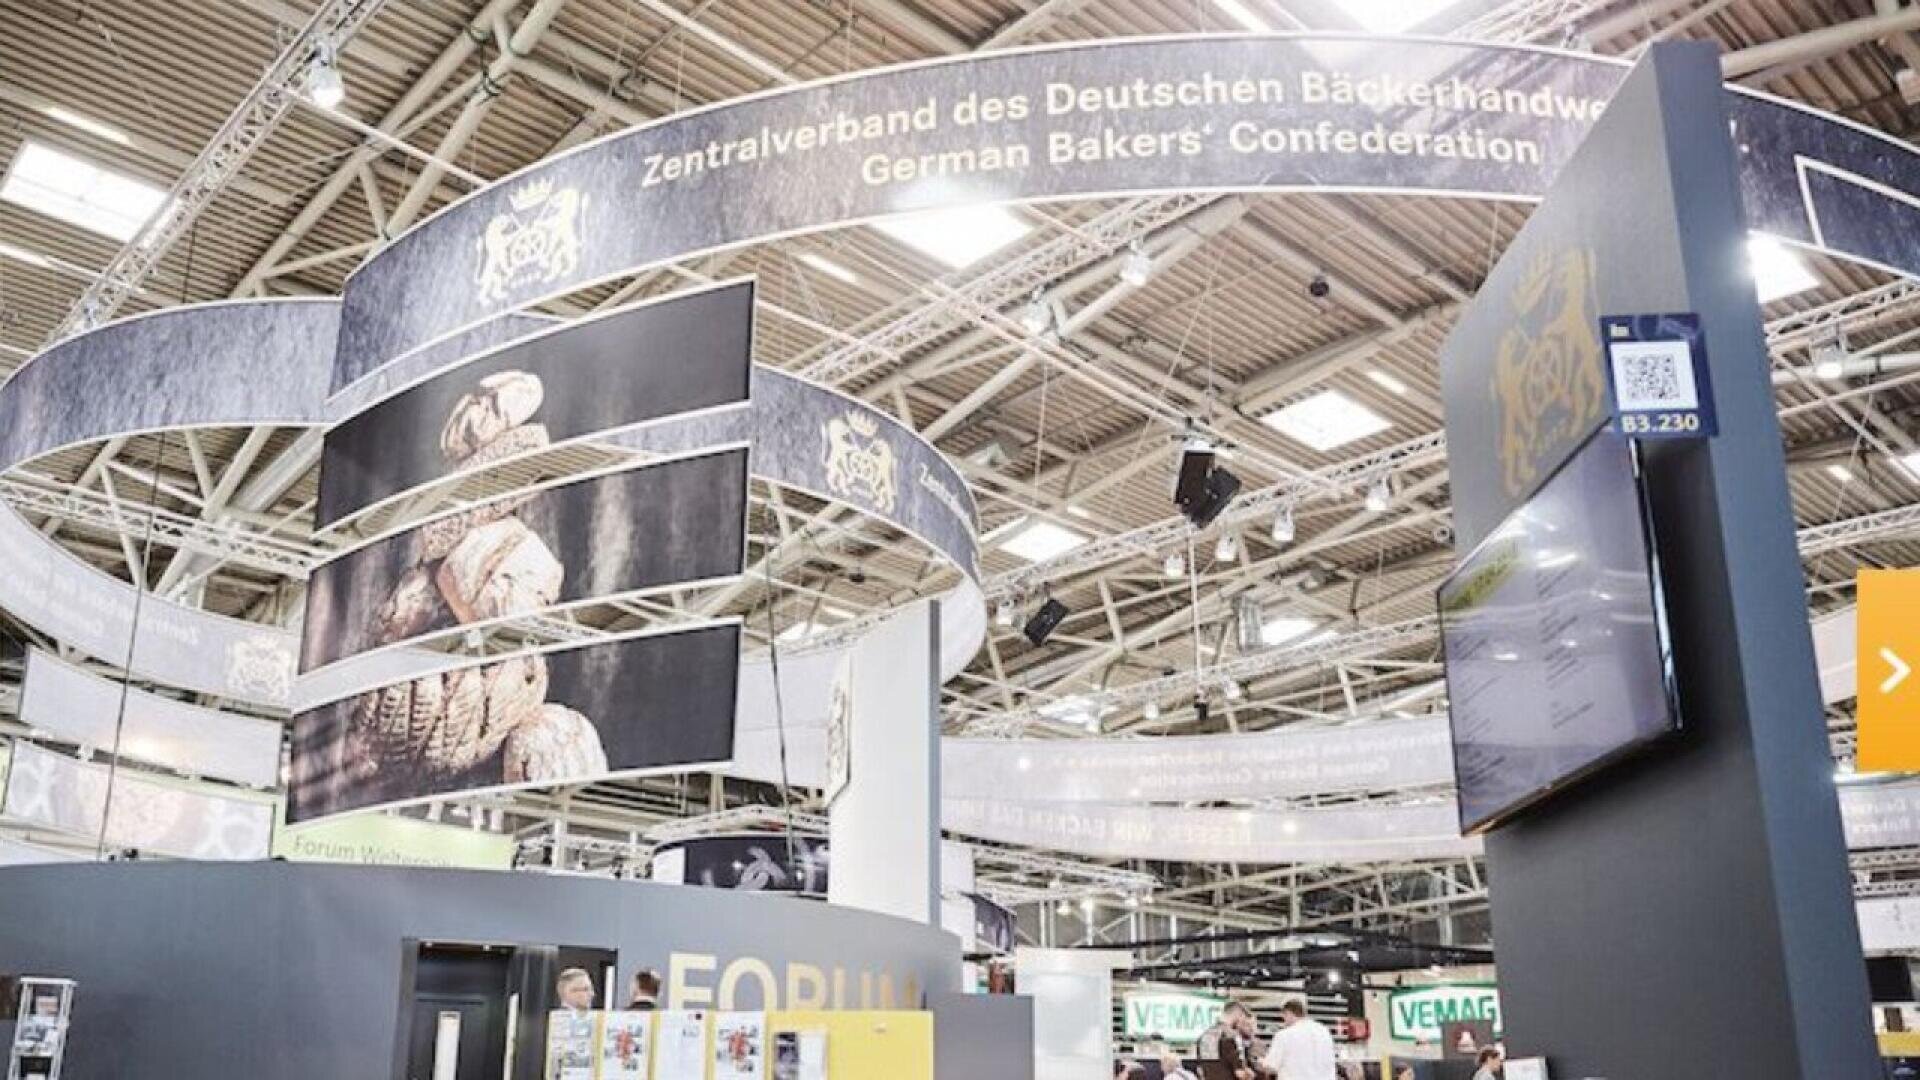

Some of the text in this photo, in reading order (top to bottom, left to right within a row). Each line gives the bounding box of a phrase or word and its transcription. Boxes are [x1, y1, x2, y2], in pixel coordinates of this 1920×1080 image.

[641, 97, 937, 187] Zentralverband
[953, 92, 1030, 126] des
[1046, 72, 1284, 115] Deutschen
[862, 143, 1030, 185] German
[1229, 120, 1540, 164] Confederation
[1621, 413, 1699, 433] B3.230
[294, 834, 355, 860] Forum
[1399, 996, 1497, 1030] VEMAG
